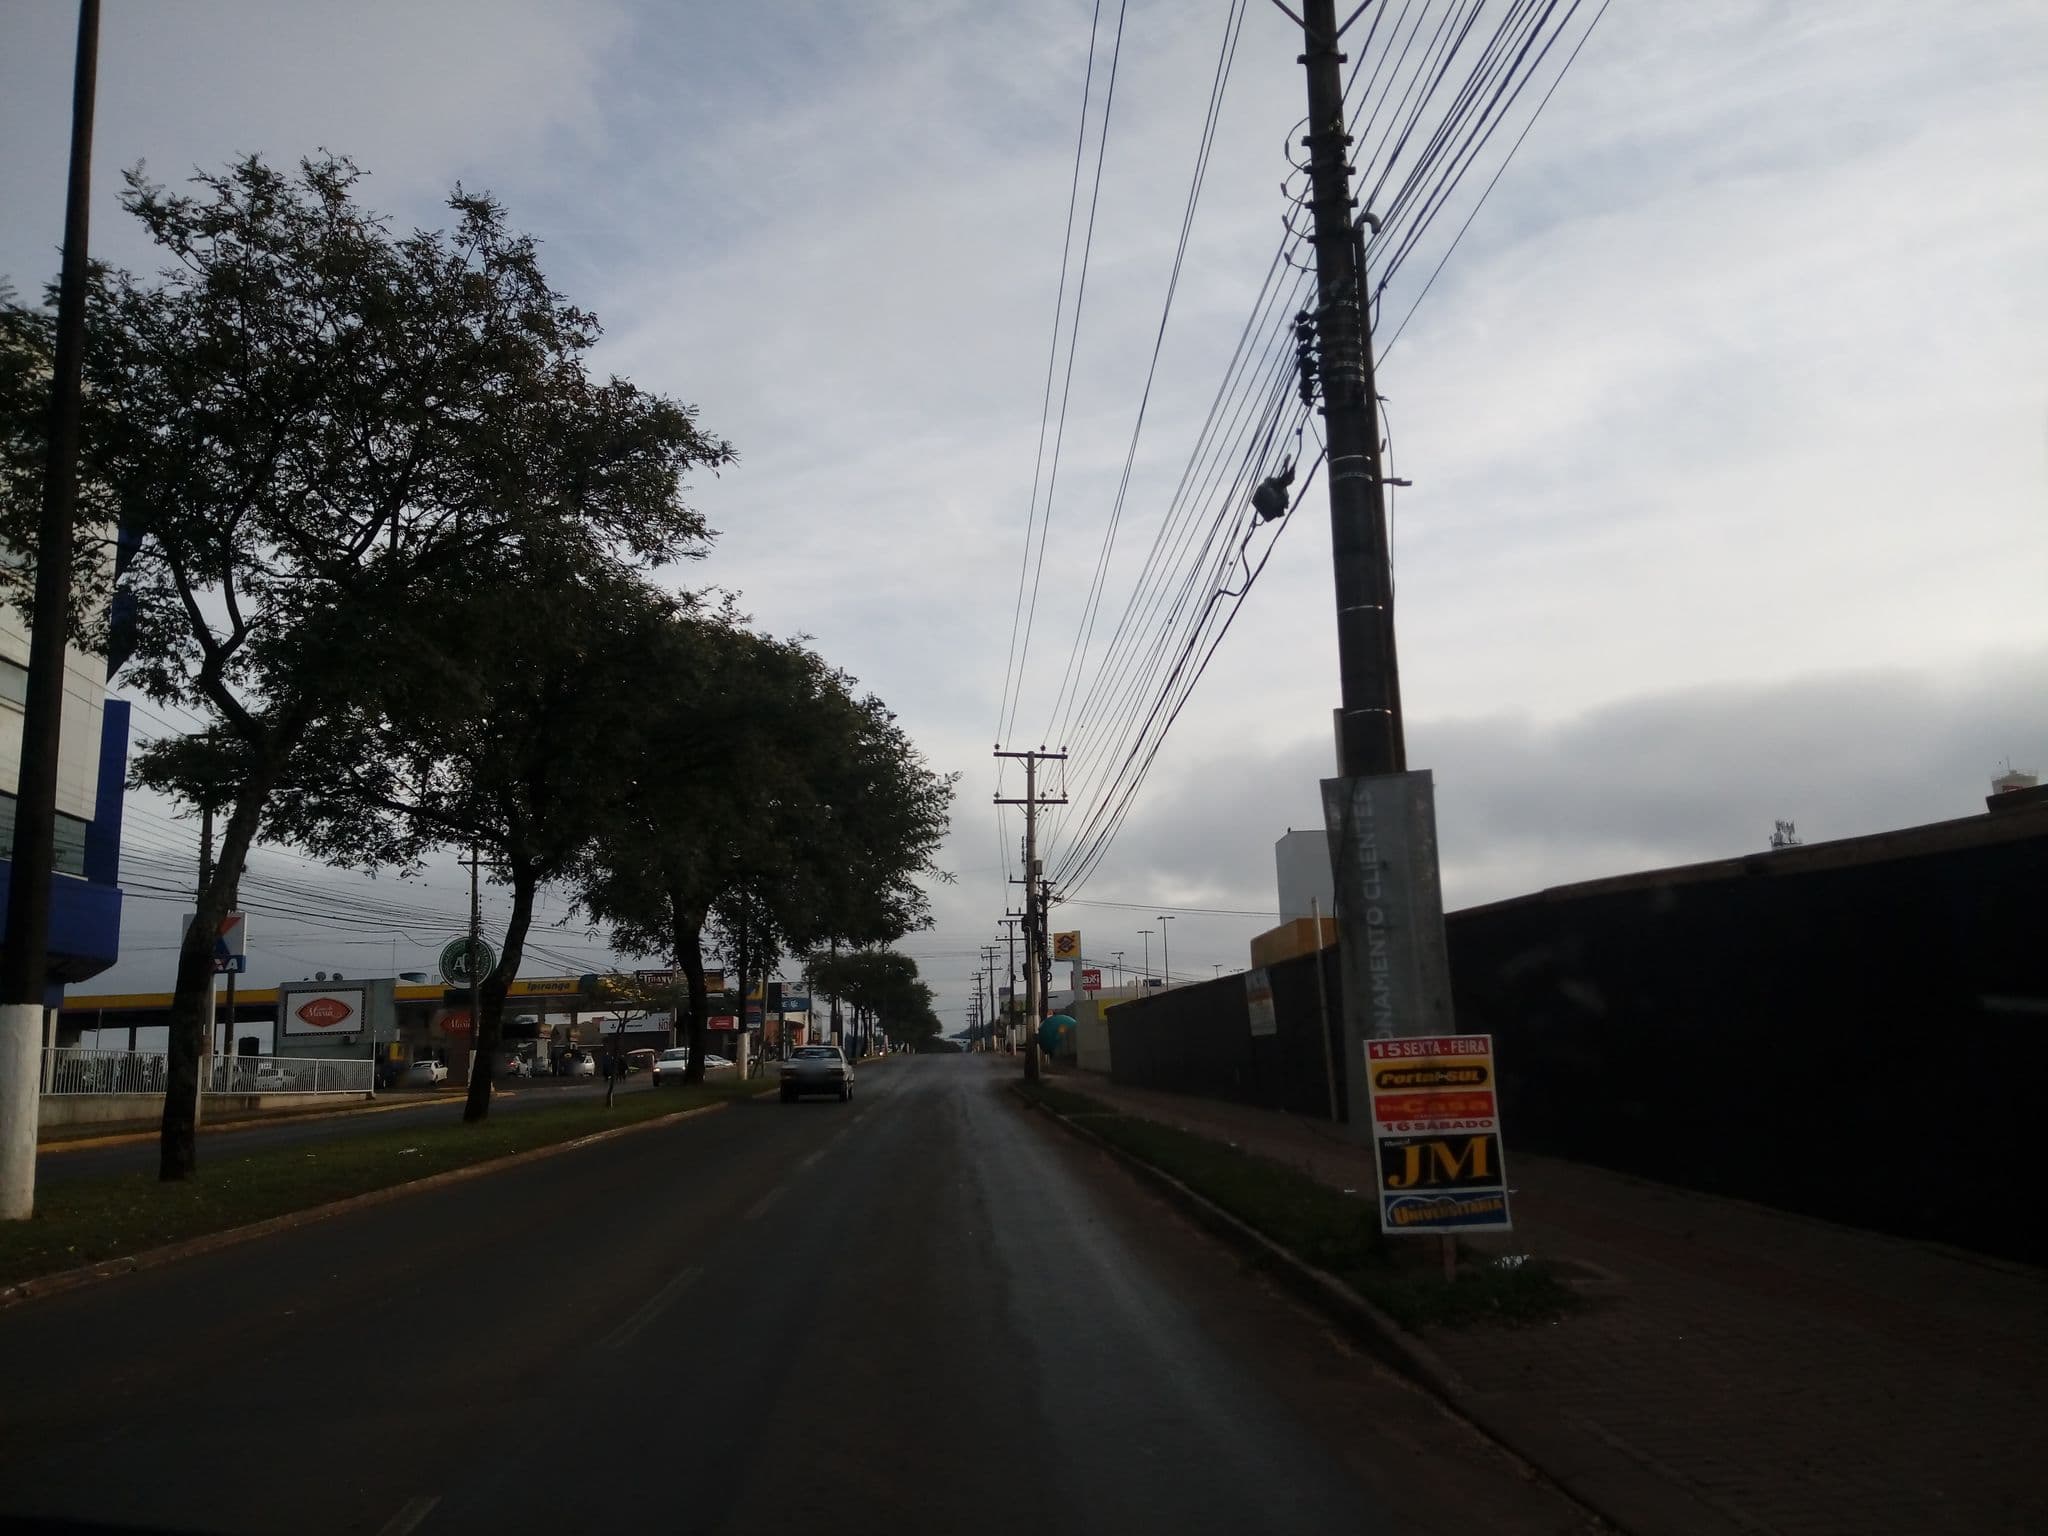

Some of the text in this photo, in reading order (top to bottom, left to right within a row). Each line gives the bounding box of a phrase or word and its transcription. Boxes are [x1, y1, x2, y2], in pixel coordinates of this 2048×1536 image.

[1352, 788, 1382, 900] CLIENTES
[1373, 1043, 1402, 1057] 15
[1403, 1041, 1441, 1056] SEXTA
[1450, 1039, 1486, 1055] FEIRA
[1383, 1121, 1410, 1132] 16
[1386, 1134, 1495, 1188] JM
